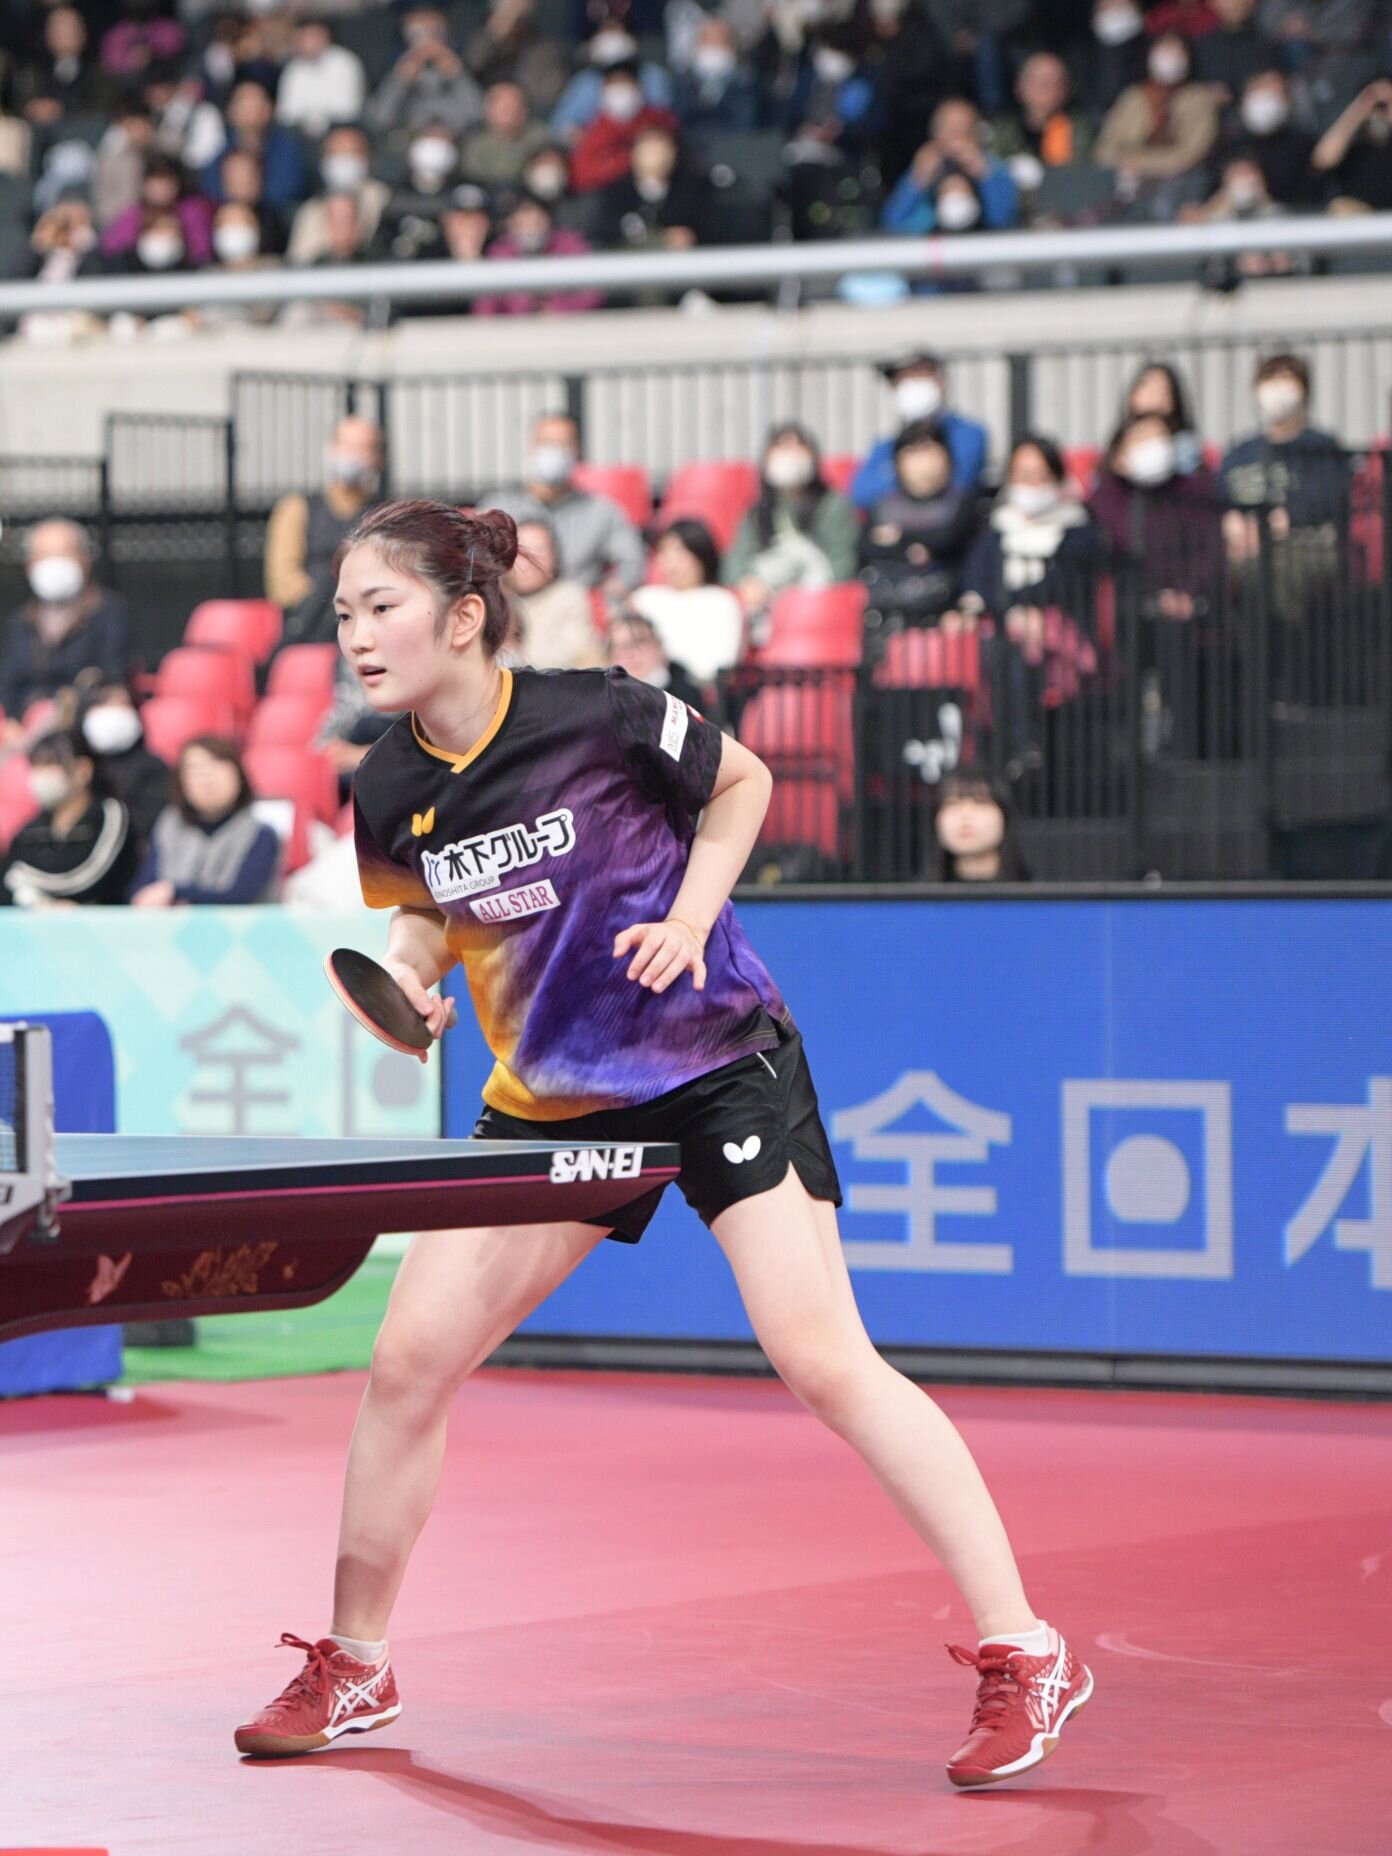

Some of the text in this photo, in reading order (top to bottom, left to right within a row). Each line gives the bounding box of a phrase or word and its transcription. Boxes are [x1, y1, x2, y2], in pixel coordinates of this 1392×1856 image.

[443, 814, 571, 882] 木下グループ
[469, 875, 496, 891] GROUP
[478, 884, 554, 921] ALL STAR
